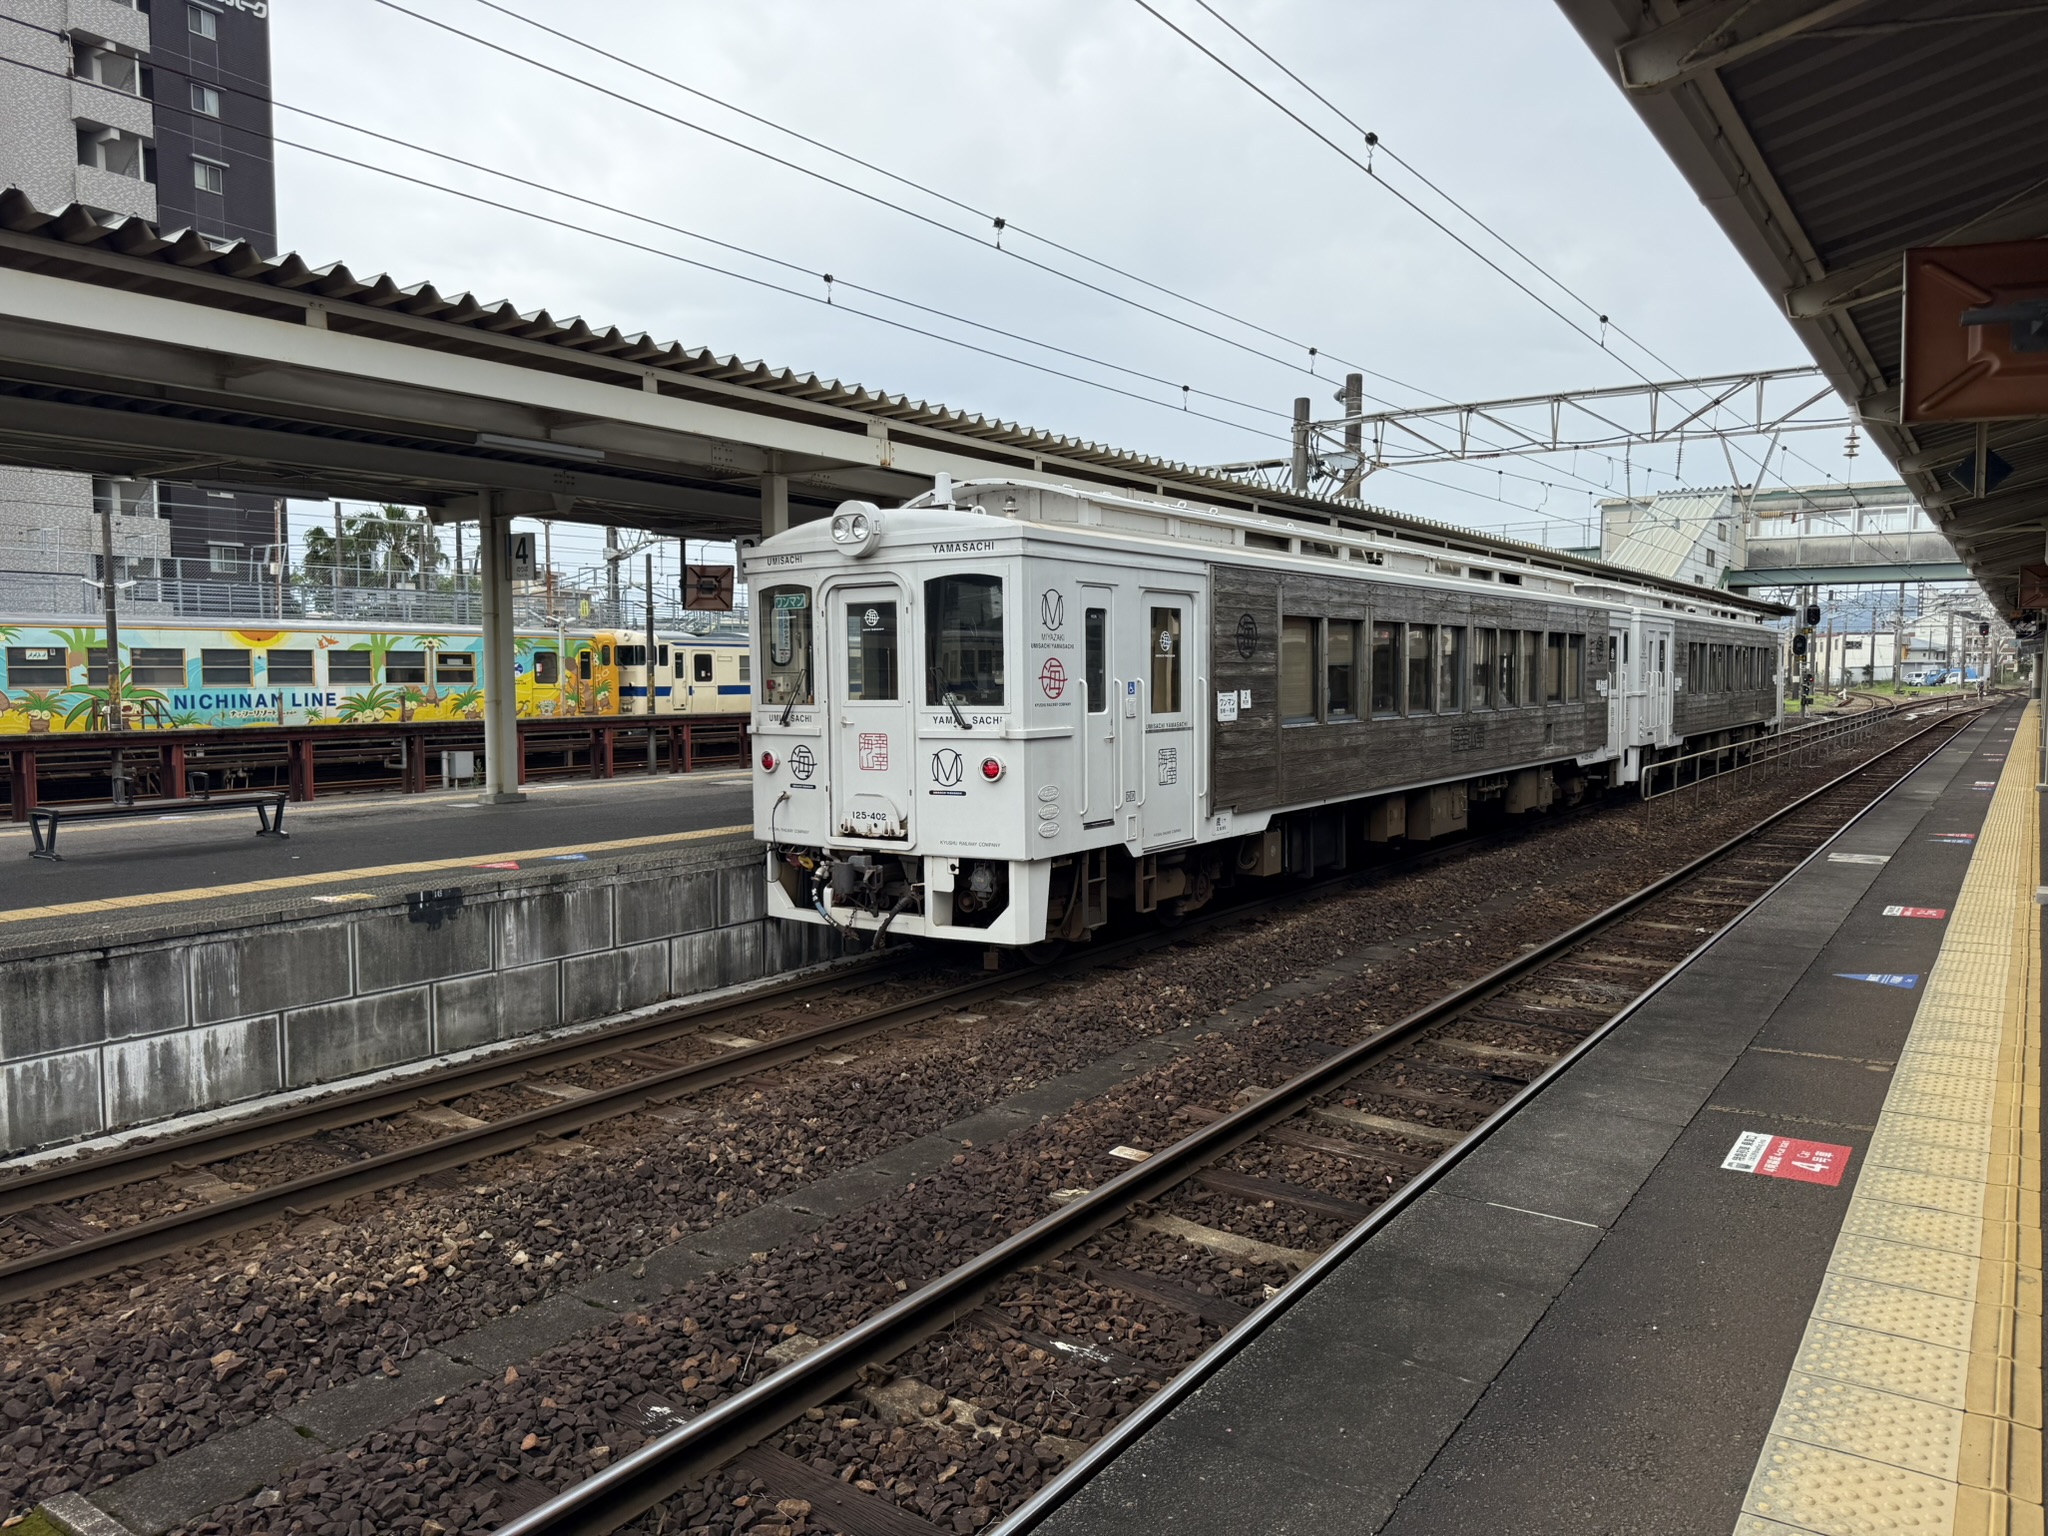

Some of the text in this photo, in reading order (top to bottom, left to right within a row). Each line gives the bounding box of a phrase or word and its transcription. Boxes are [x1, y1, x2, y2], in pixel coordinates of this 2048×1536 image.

[515, 537, 528, 564] 4
[933, 541, 995, 553] YAMASACHI
[767, 555, 803, 566] UMISACHI
[775, 596, 804, 608] ワンマン
[174, 692, 337, 710] NICHINAN LINE
[790, 714, 813, 723] SACHI
[852, 811, 887, 821] 125-402
[1791, 1160, 1829, 1172] 4
